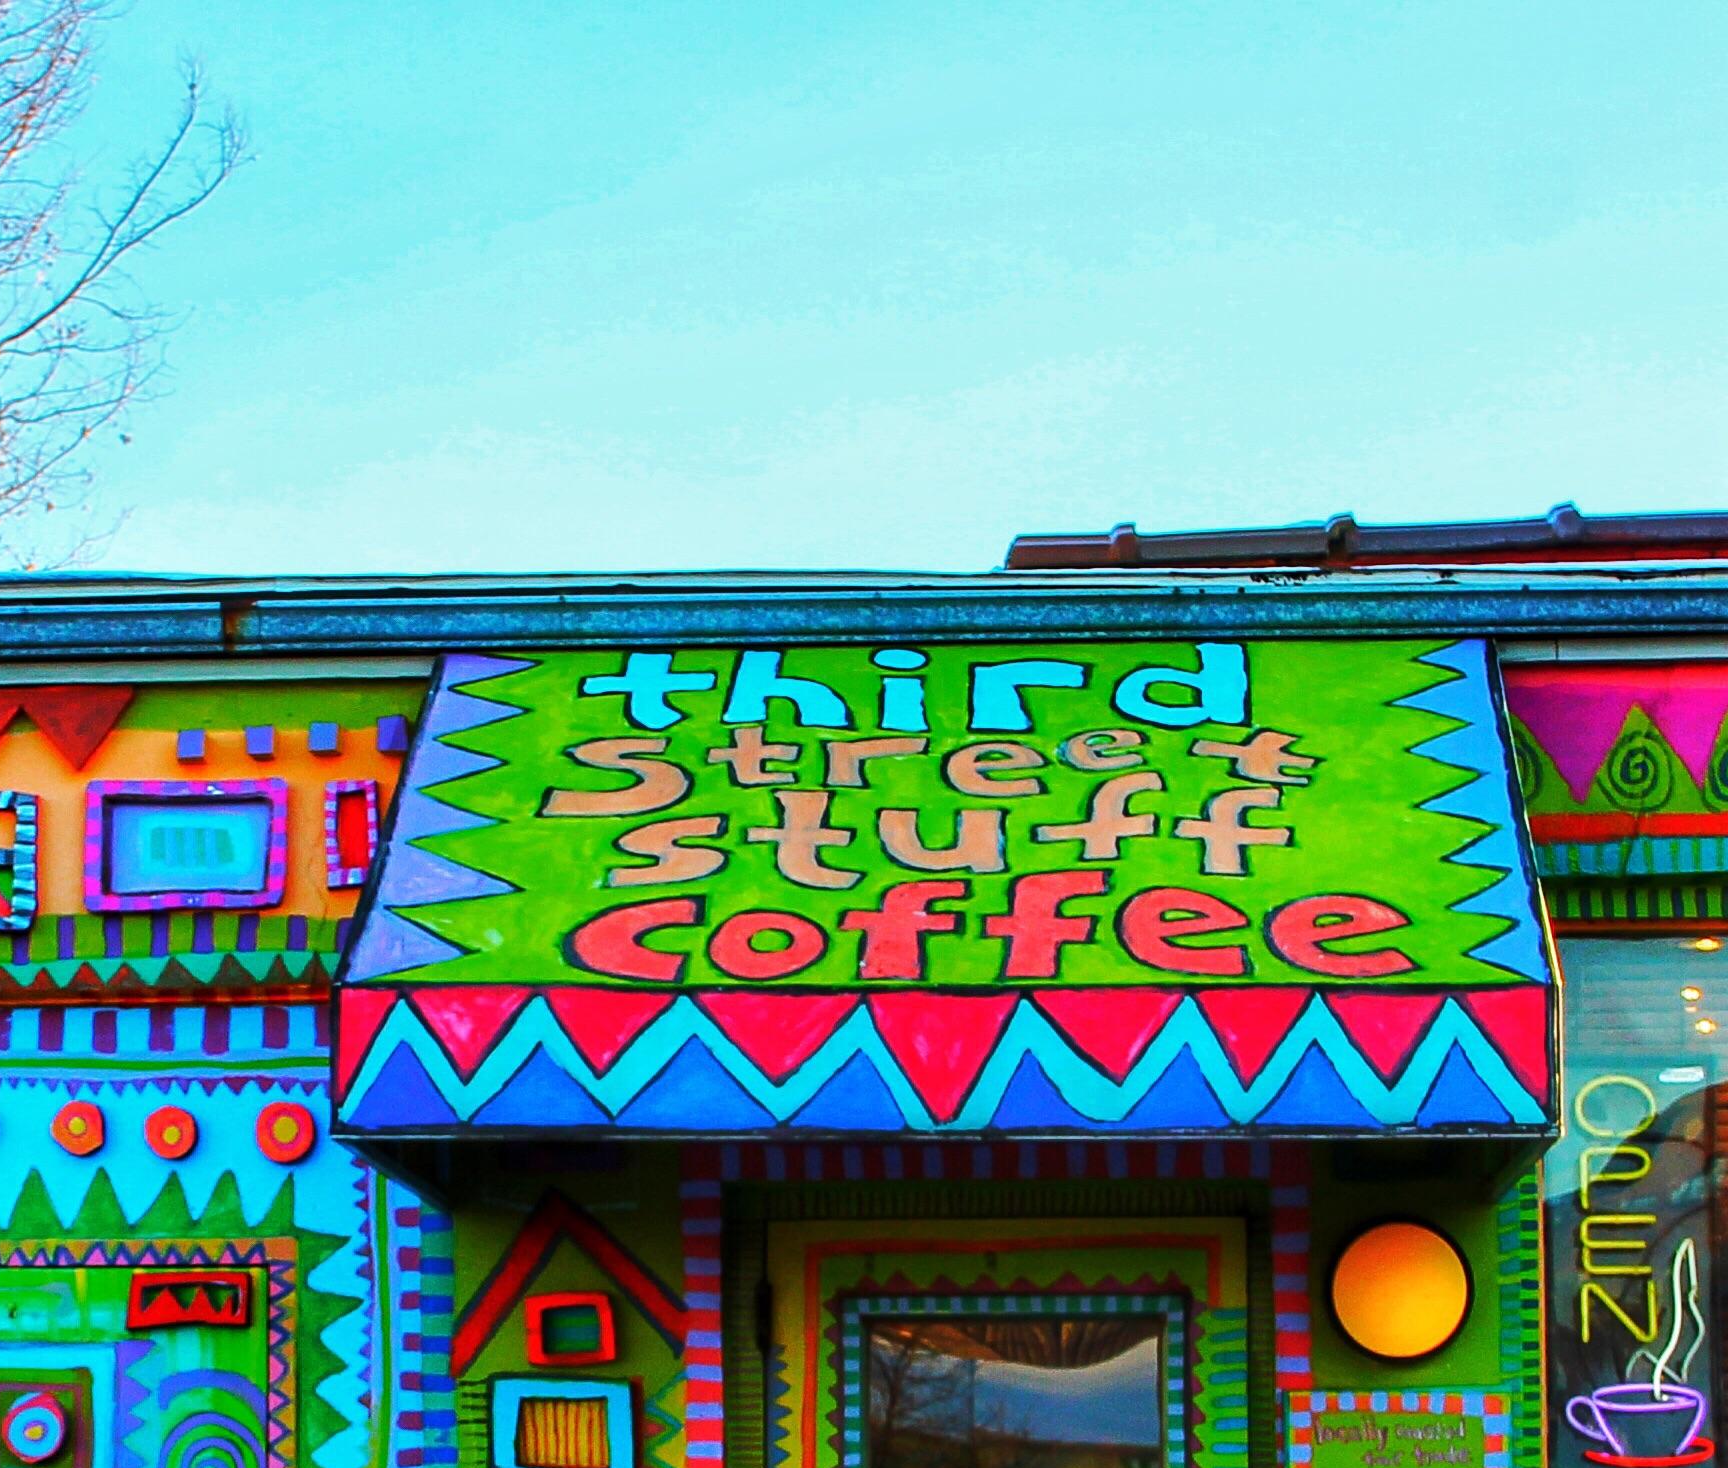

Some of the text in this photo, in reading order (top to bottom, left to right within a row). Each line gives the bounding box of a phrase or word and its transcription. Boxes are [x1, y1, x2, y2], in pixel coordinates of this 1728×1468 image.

[582, 643, 1254, 733] third
[602, 770, 1300, 891] stuff
[559, 869, 1427, 984] coffee
[1574, 1074, 1657, 1343] OPEN
